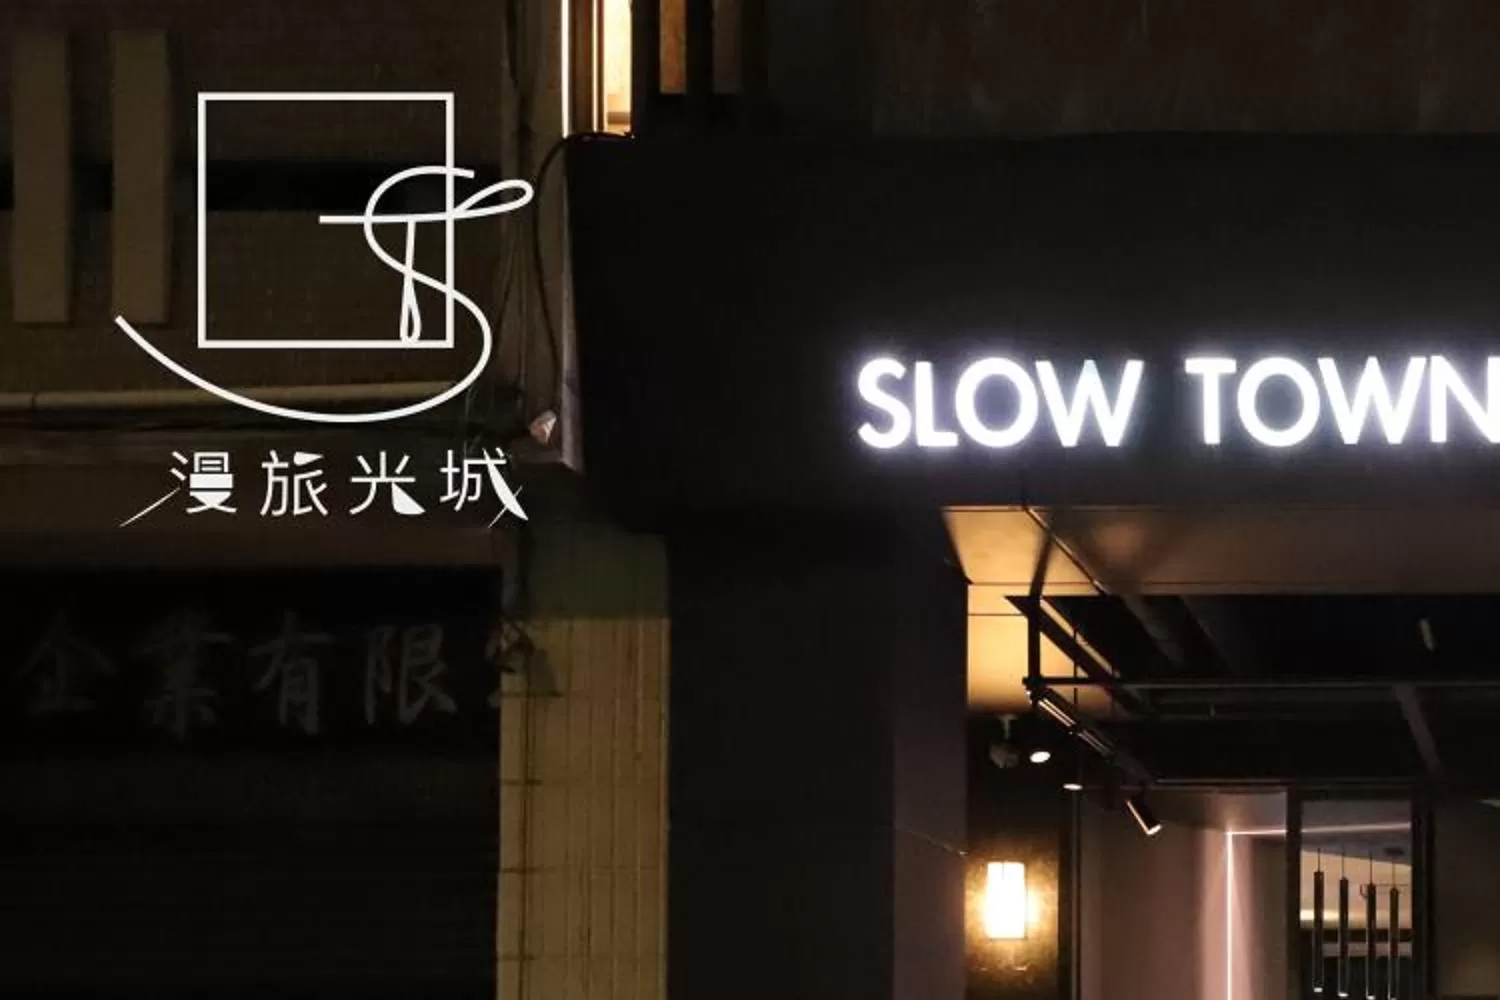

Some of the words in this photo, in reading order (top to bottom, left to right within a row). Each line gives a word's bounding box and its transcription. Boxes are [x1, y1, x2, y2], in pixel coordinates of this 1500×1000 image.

[856, 356, 1145, 449] SLOW
[14, 602, 500, 744] 企業有限
